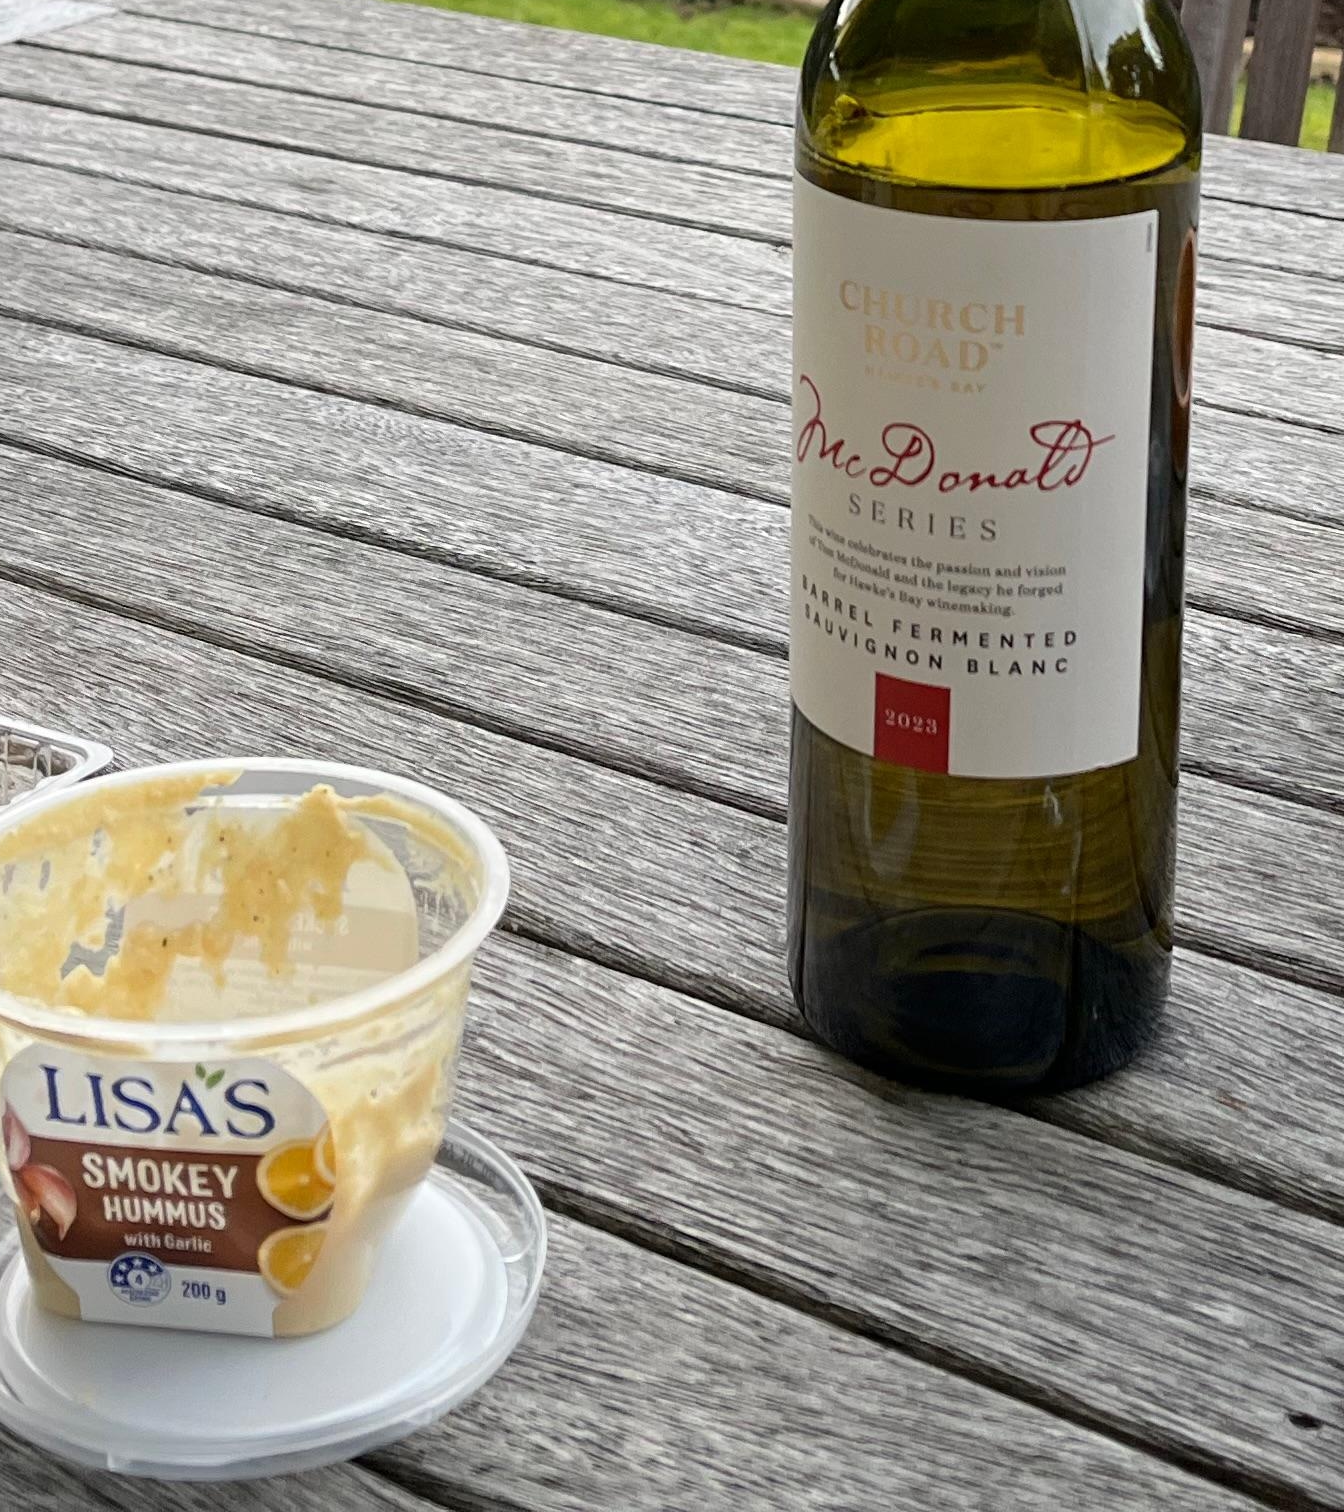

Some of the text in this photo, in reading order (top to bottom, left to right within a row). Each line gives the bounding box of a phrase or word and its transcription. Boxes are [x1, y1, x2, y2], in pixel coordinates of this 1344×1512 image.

[839, 279, 1025, 336] CHURCH
[797, 375, 1116, 493] McDonald
[847, 491, 999, 542] SERIES
[911, 555, 933, 571] the
[936, 561, 991, 578] passion
[995, 563, 1022, 578] and
[1026, 564, 1067, 578] vision
[894, 572, 918, 588] and
[922, 576, 944, 592] the
[947, 580, 992, 598] legacy
[996, 583, 1014, 597] he
[1017, 582, 1064, 599] forged
[899, 591, 923, 609] Bay
[802, 574, 1078, 649] BARREL FERMENTED
[805, 603, 1068, 676] SAUVIGNON BLANC
[884, 707, 938, 736] 2023
[82, 1152, 239, 1200] SMOKEY
[103, 1195, 227, 1232] HUMMUS
[124, 1233, 213, 1254] with Garlic
[182, 1279, 211, 1300] 200
[216, 1289, 227, 1306] g
